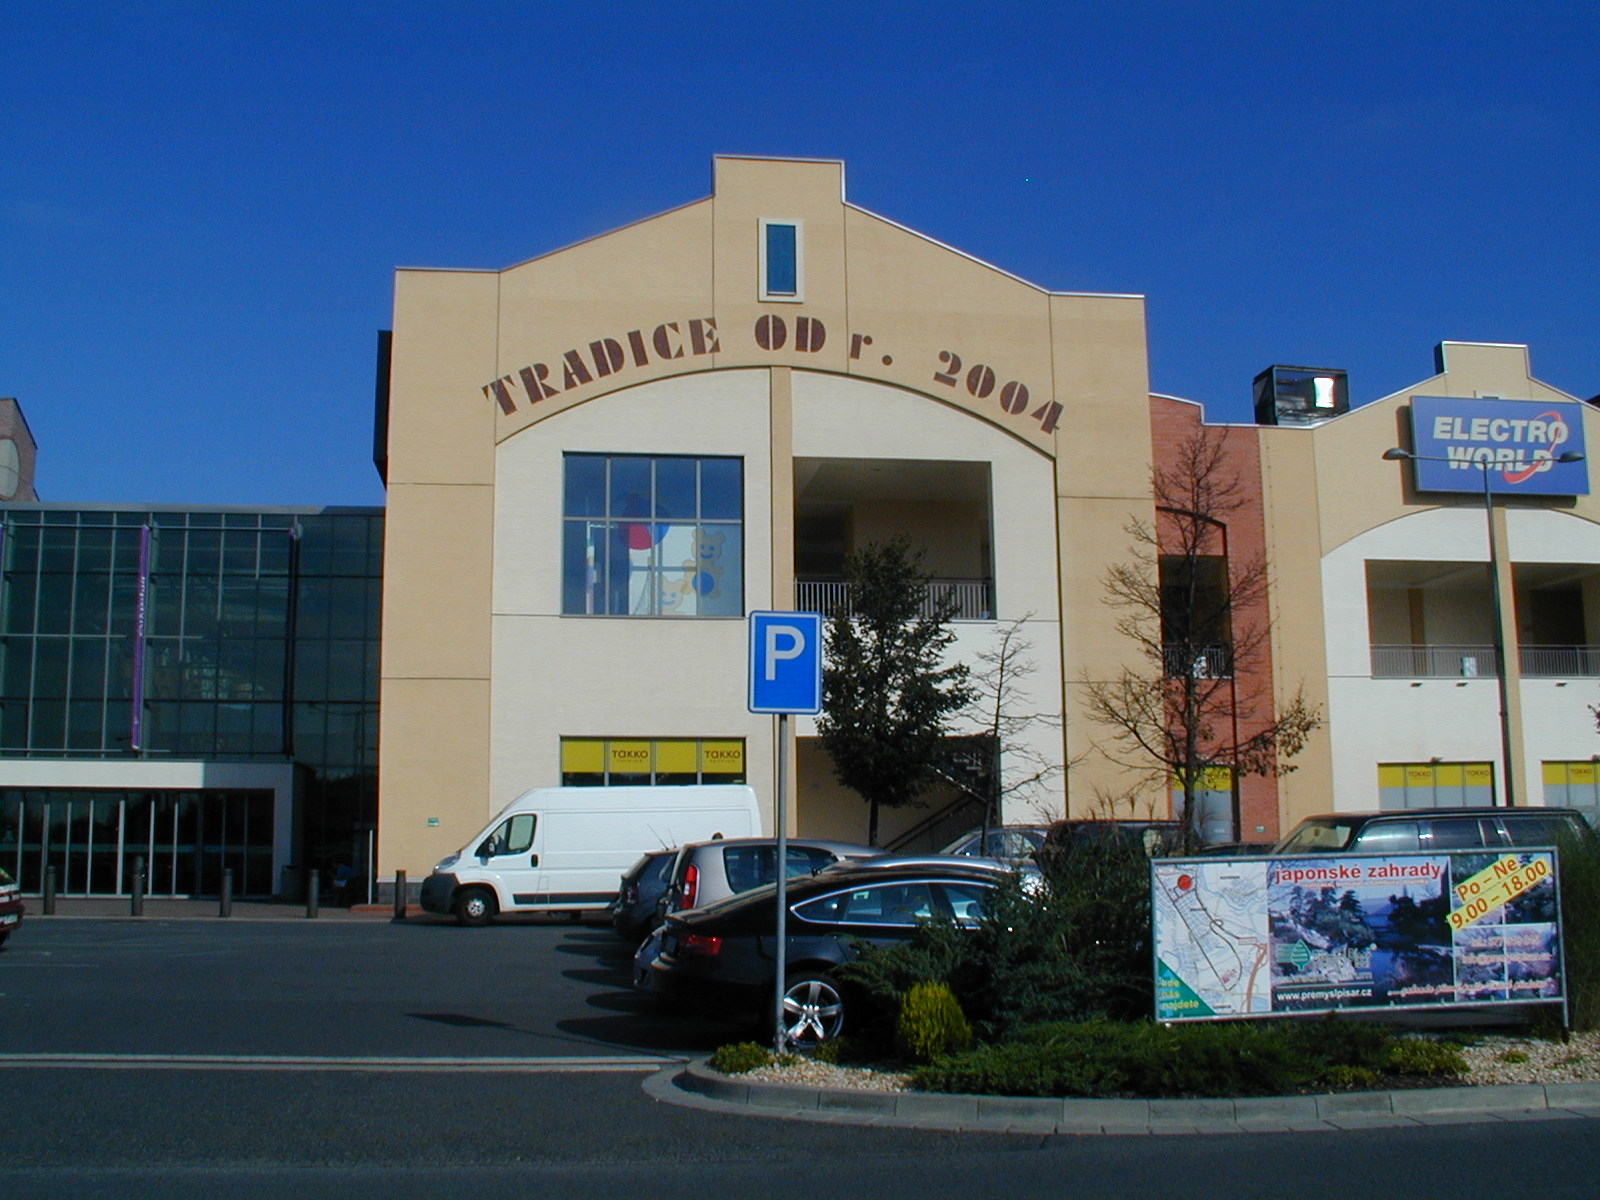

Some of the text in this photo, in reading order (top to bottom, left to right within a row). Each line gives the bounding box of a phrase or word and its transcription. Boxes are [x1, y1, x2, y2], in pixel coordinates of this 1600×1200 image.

[482, 314, 1065, 434] TRADICE OD r. 2004
[1433, 416, 1569, 444] ELECTRO
[1447, 446, 1553, 473] WORLD
[765, 625, 805, 681] P
[1275, 863, 1361, 884] japonské
[1368, 862, 1441, 880] zahrady
[1451, 898, 1488, 929] 9.00
[1502, 860, 1547, 897] 18.00
[1457, 882, 1481, 902] Po
[1493, 859, 1518, 880] Ne
